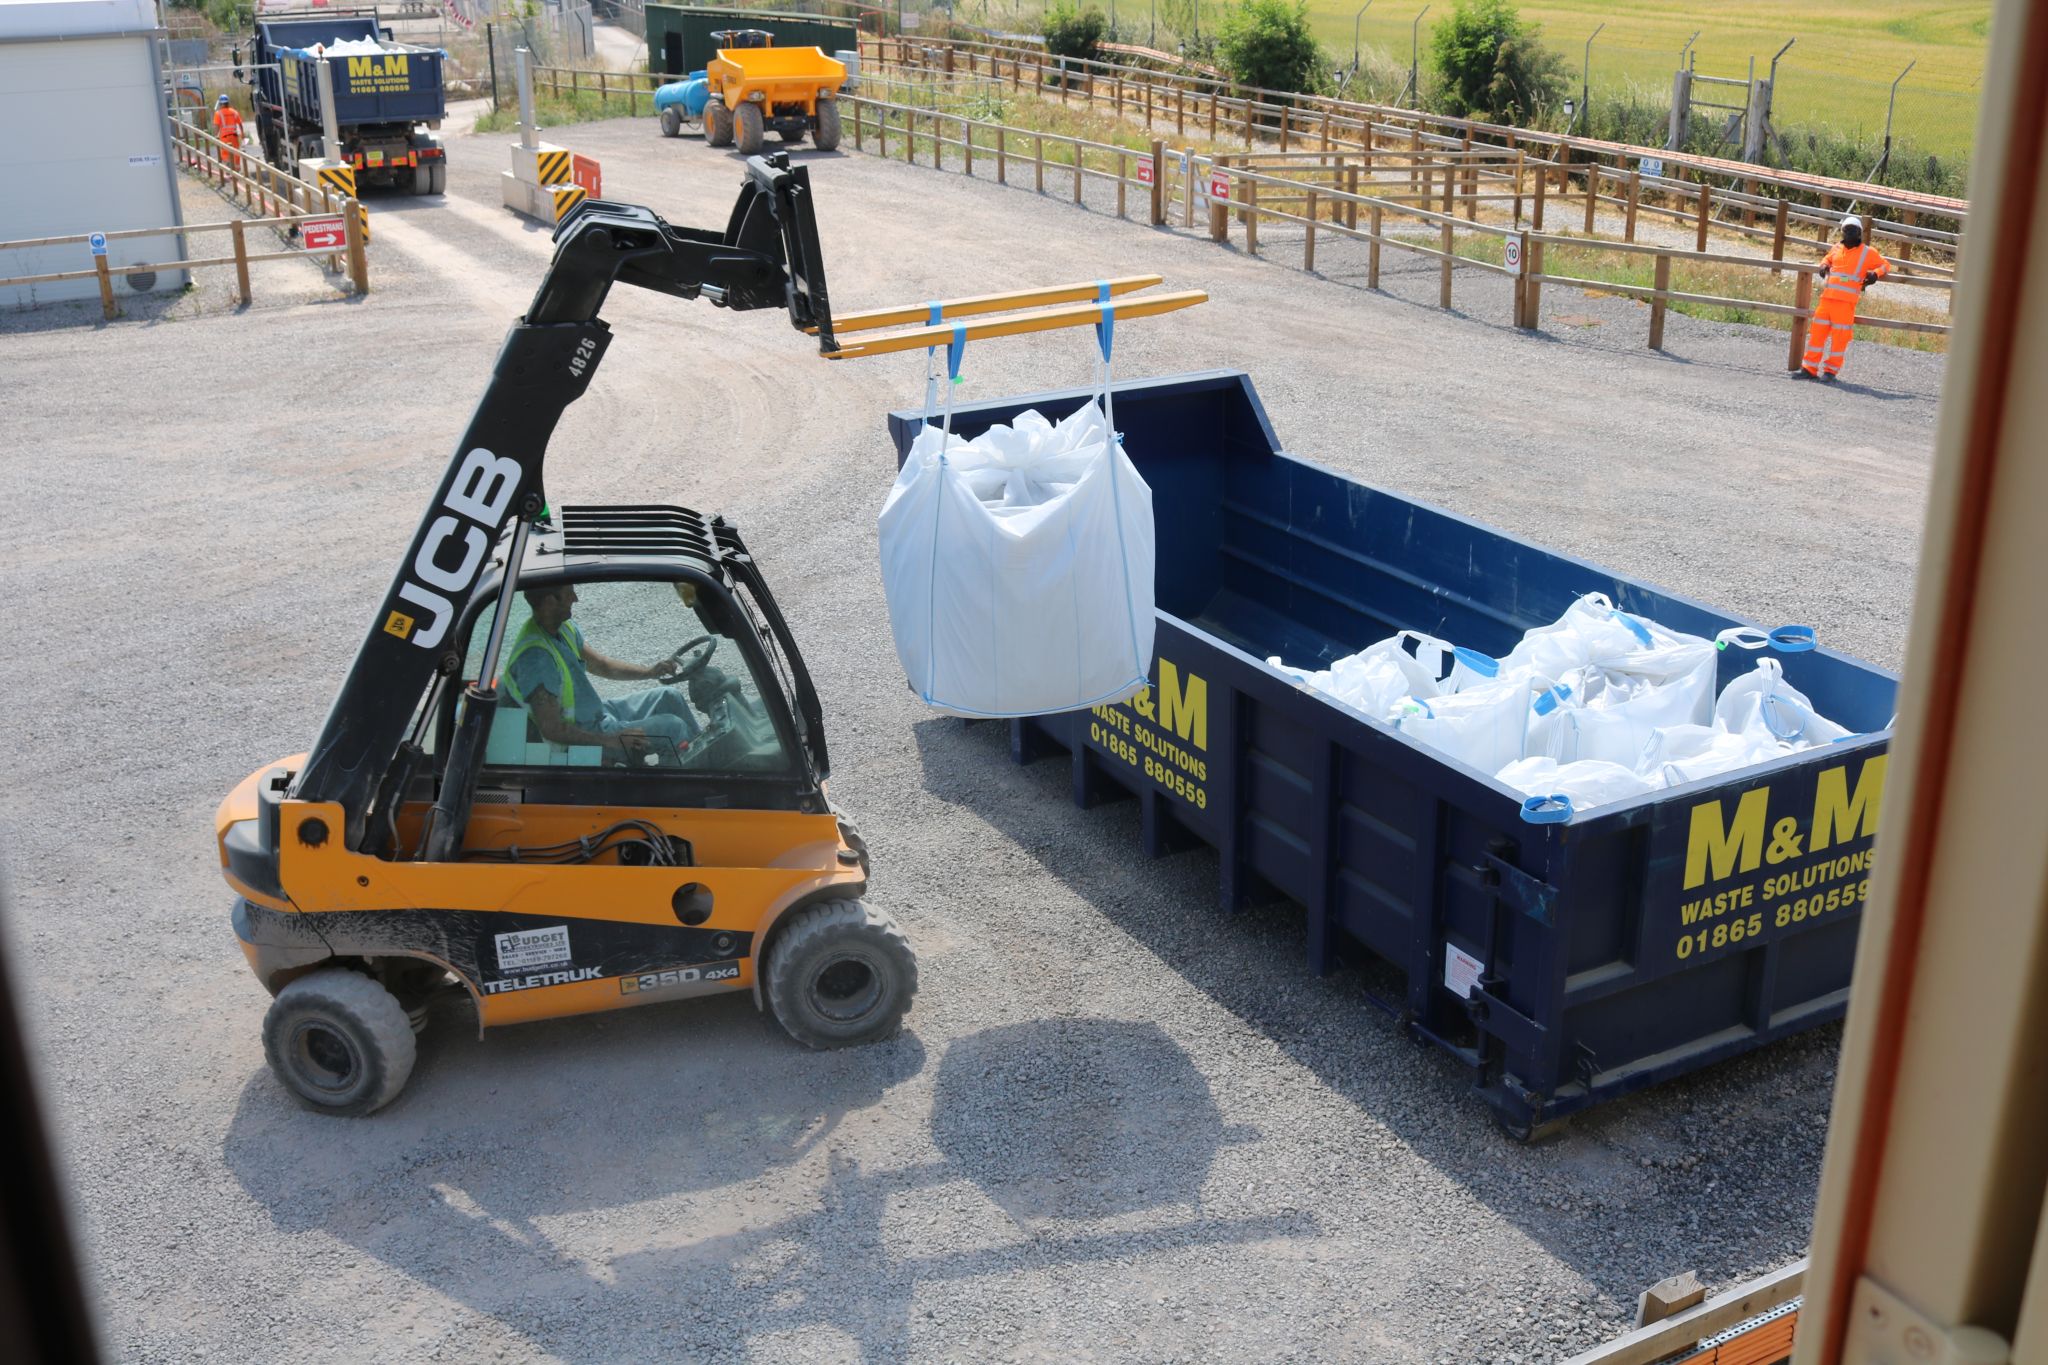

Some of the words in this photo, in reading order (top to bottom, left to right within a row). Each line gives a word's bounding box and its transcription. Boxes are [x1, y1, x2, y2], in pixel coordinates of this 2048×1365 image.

[348, 55, 409, 77] M&M
[374, 77, 409, 85] SOLUTIONS
[304, 222, 344, 234] PEDESTRIANS
[1508, 248, 1517, 259] 10
[568, 337, 597, 378] 4826
[399, 447, 523, 649] JCB
[1121, 657, 1207, 752] &M
[1092, 700, 1130, 736] WASTE
[1134, 723, 1207, 782] SOLUTIONS
[1091, 722, 1137, 766] 01865
[1144, 756, 1207, 810] 880559
[1683, 753, 1889, 891] M&M
[1681, 885, 1754, 926] WASTE
[1762, 848, 1875, 900] SOLUTIONS
[511, 932, 565, 946] BUDGET
[1676, 913, 1762, 960] 01865
[1775, 879, 1872, 928] 880559
[484, 966, 603, 994] TELETRUK
[639, 968, 701, 991] 35D
